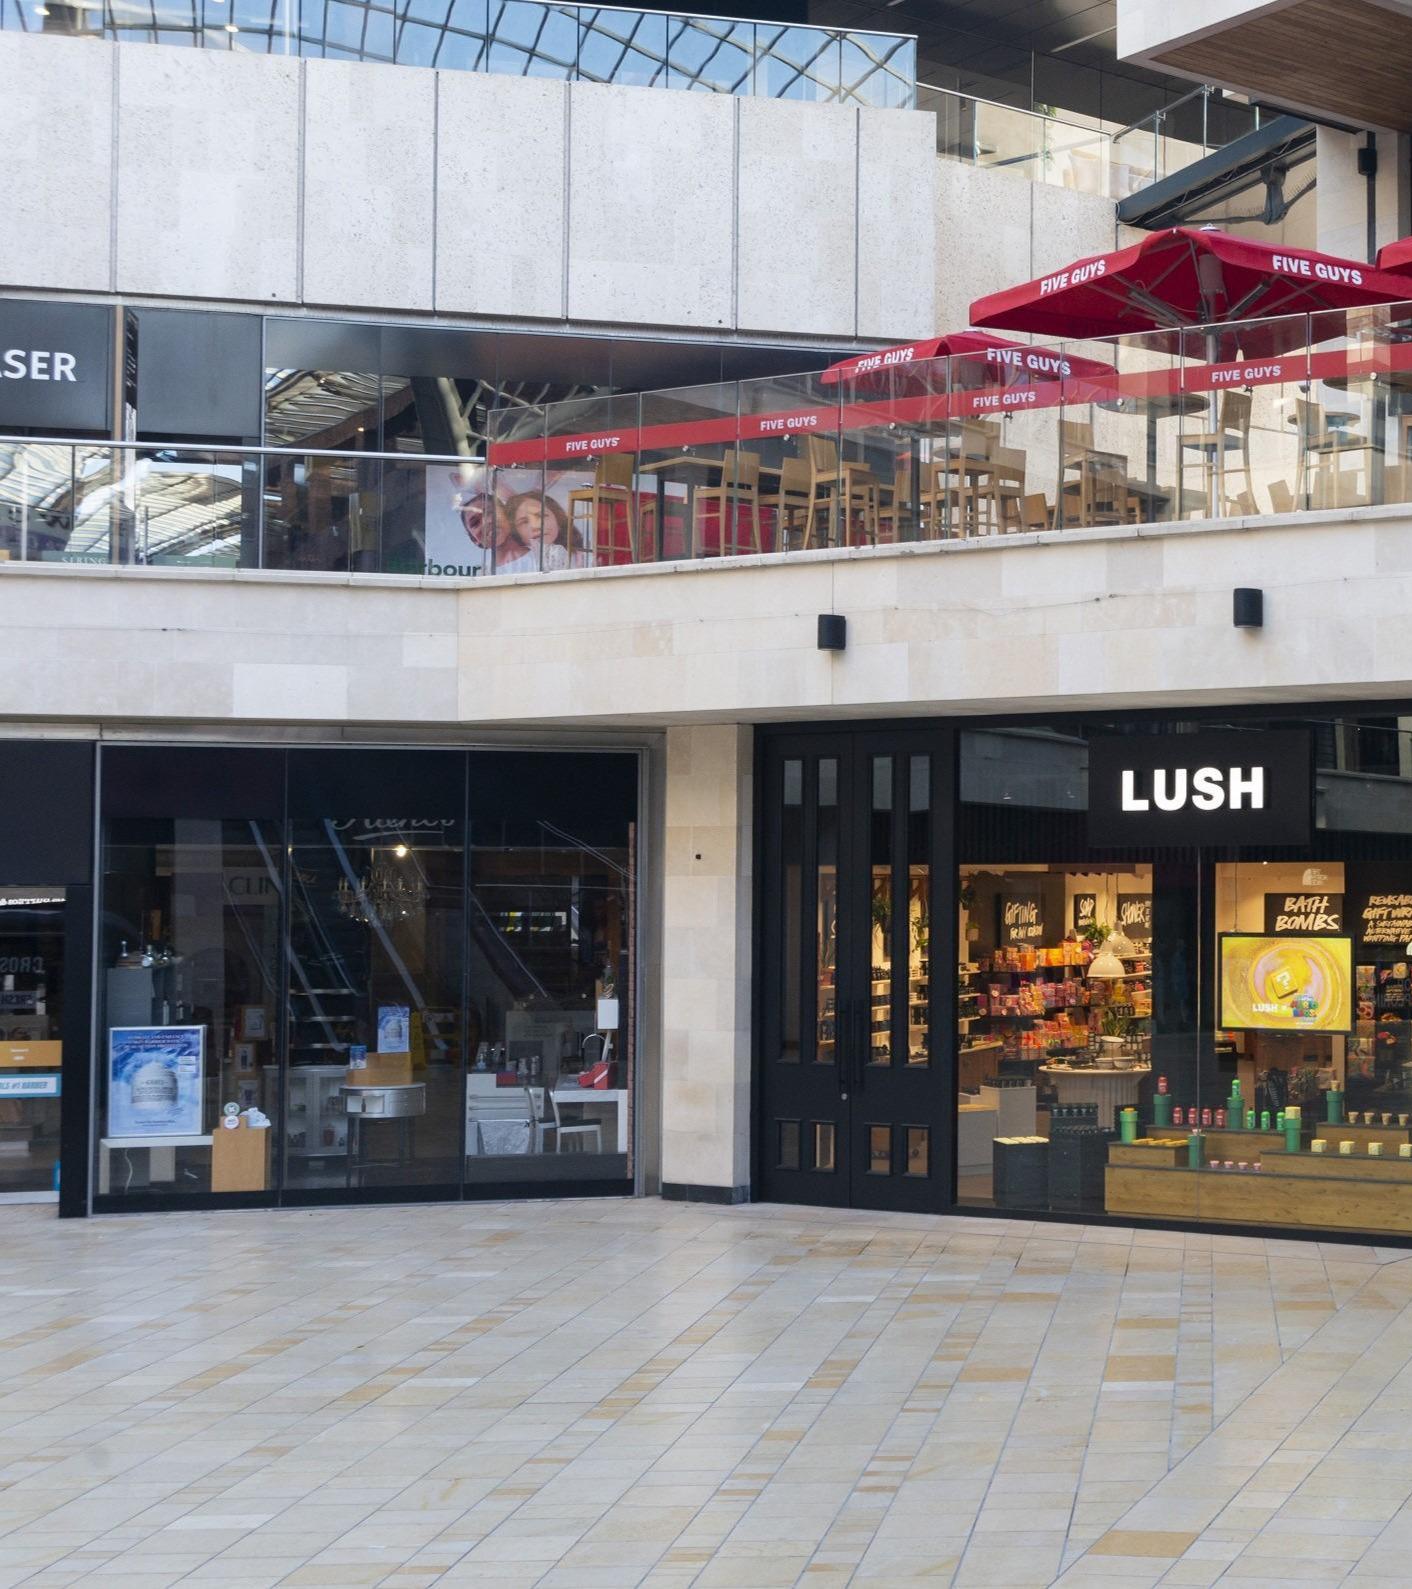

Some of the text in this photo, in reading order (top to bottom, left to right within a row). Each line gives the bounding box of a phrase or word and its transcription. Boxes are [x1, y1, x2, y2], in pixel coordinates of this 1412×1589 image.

[1040, 259, 1106, 295] FIVE GUYS
[1272, 255, 1363, 285] FIVE GUYS
[0, 349, 77, 381] SER
[855, 348, 914, 373] FIVE GUYS
[987, 348, 1071, 376] FIVE GUYS
[1212, 365, 1281, 382] FIVE GUYS
[973, 391, 1036, 408] FIVE GUYS
[760, 415, 817, 431] FIVE GUYS
[566, 437, 619, 452] FIVE GUYS
[1122, 766, 1264, 811] LUSH
[1284, 895, 1330, 914] BATH
[1362, 906, 1391, 919] GIFT
[1275, 914, 1340, 932] BOMBS
[1252, 1003, 1278, 1012] LUSH
